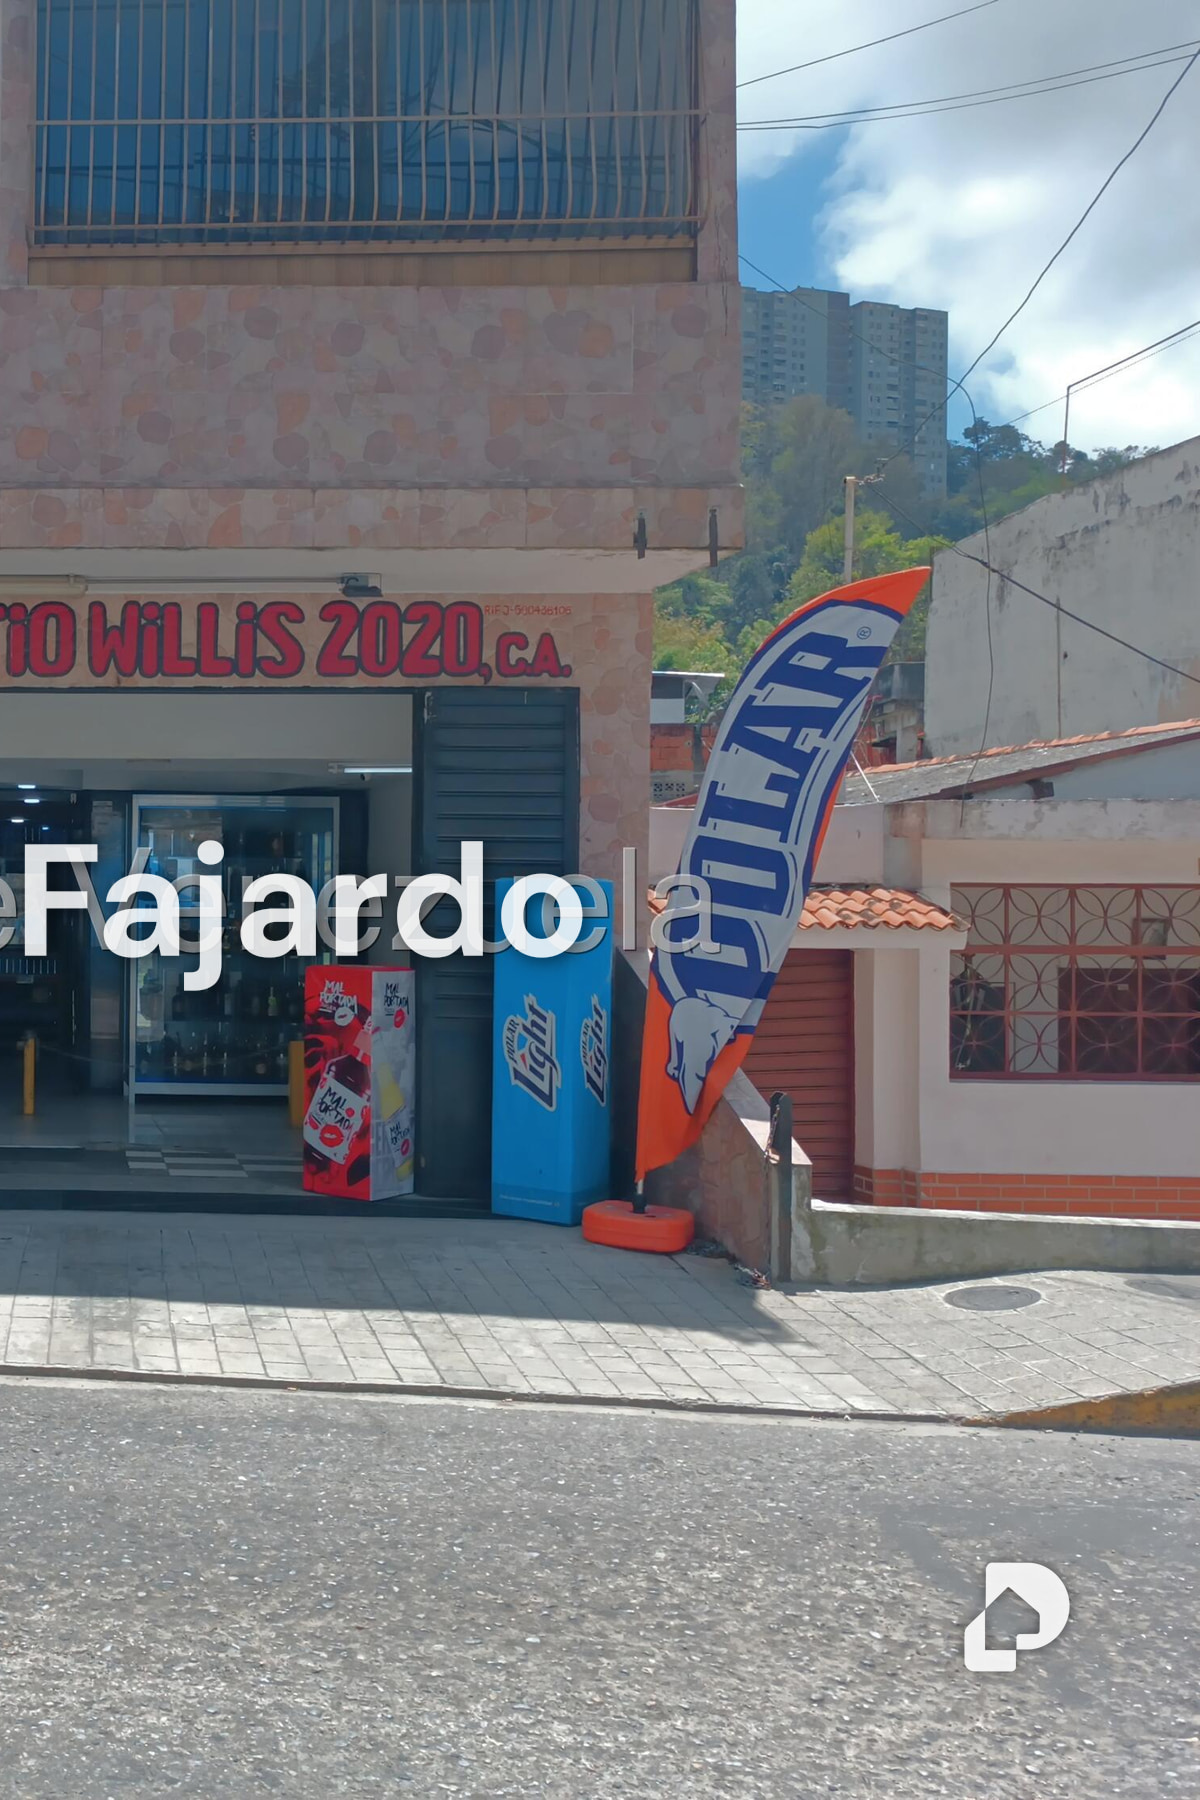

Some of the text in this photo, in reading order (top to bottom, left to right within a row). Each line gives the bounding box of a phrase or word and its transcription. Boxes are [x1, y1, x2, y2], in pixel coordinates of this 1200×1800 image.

[669, 628, 889, 1001] POLAR
[512, 1002, 559, 1108] Light
[586, 1003, 607, 1103] Light
